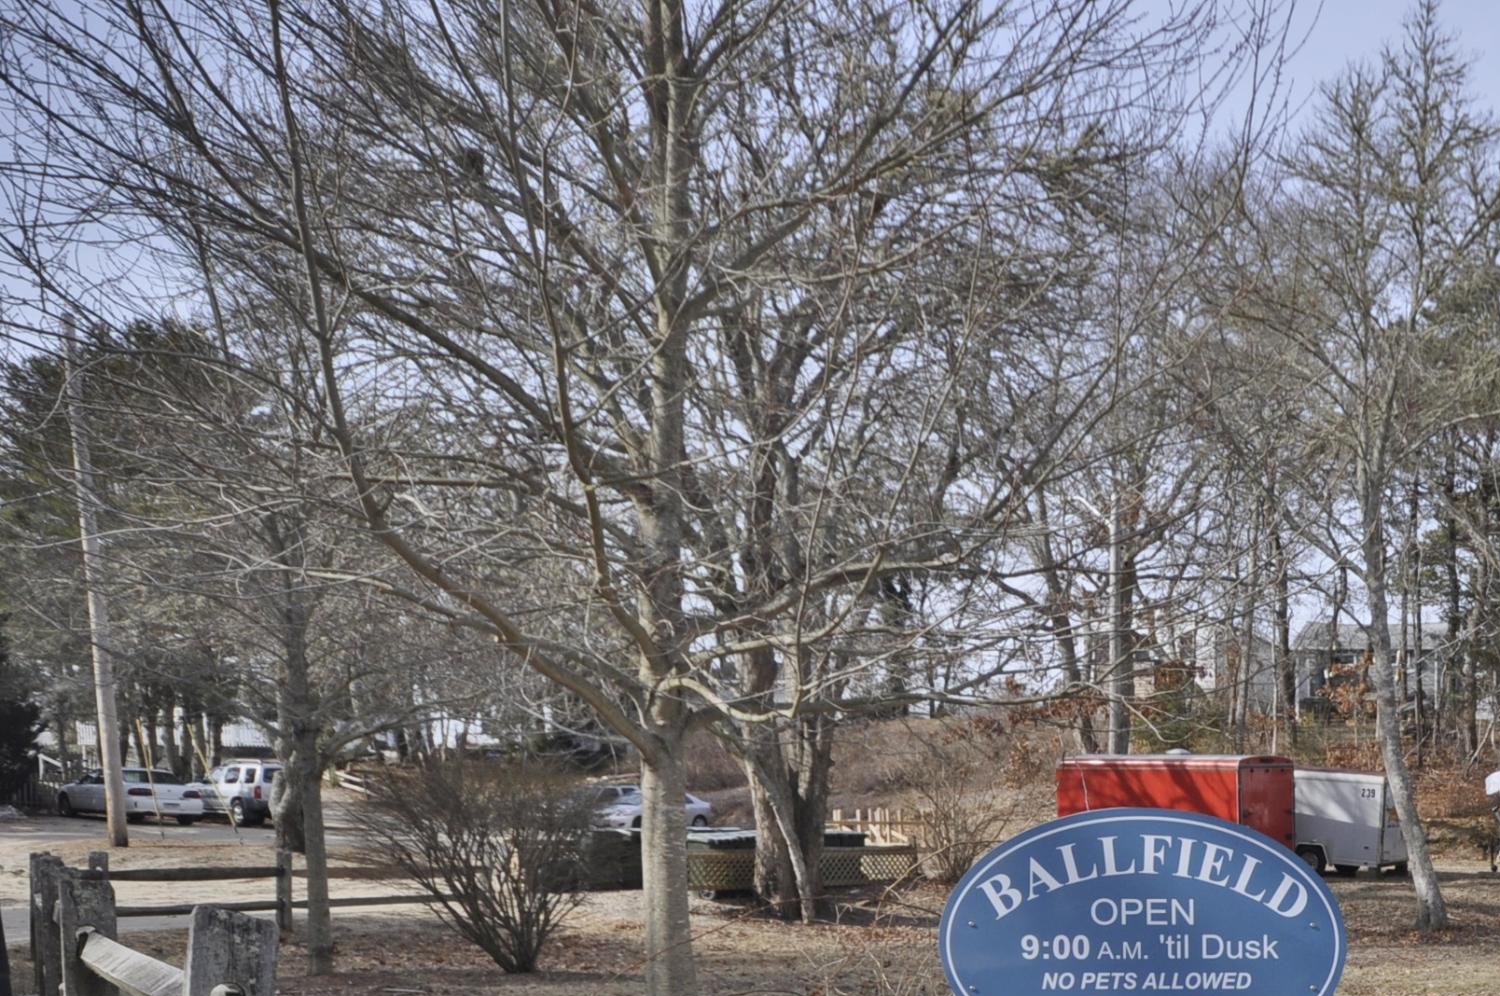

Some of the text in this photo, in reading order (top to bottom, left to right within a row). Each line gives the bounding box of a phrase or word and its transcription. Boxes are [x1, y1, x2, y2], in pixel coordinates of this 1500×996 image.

[976, 834, 1308, 920] BALLFIELD
[1091, 898, 1195, 926] OPEN
[1020, 934, 1279, 961] 9:00 A.M. 'til Dusk
[1041, 972, 1252, 991] NO PETS ALLOWED
